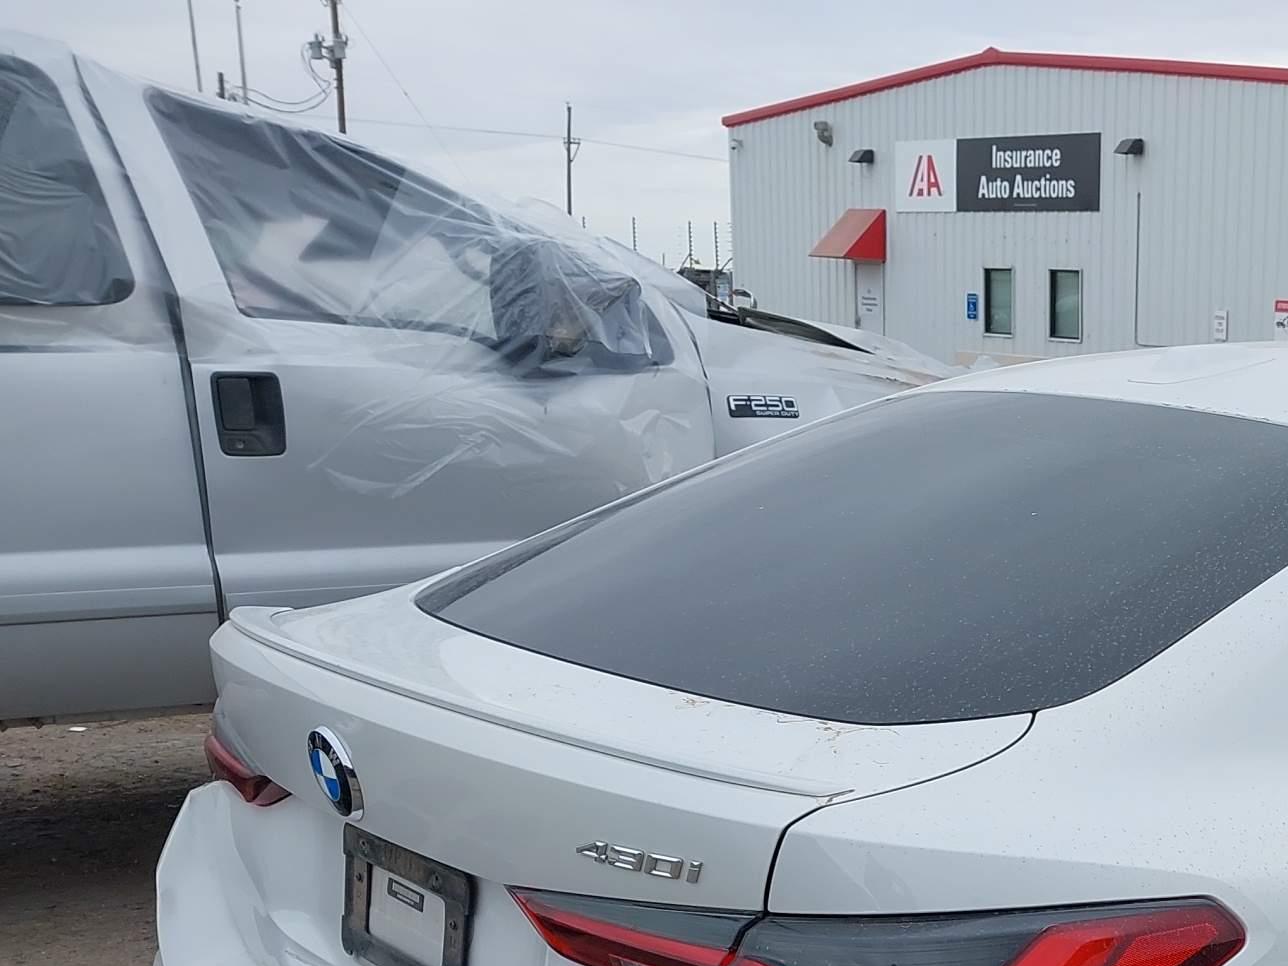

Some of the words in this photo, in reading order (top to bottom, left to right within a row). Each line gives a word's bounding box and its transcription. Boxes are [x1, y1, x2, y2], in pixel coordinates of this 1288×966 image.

[991, 145, 1061, 169] Insurance
[978, 176, 1009, 199] Auto
[1013, 174, 1075, 198] Auctions
[576, 840, 703, 884] 430i
